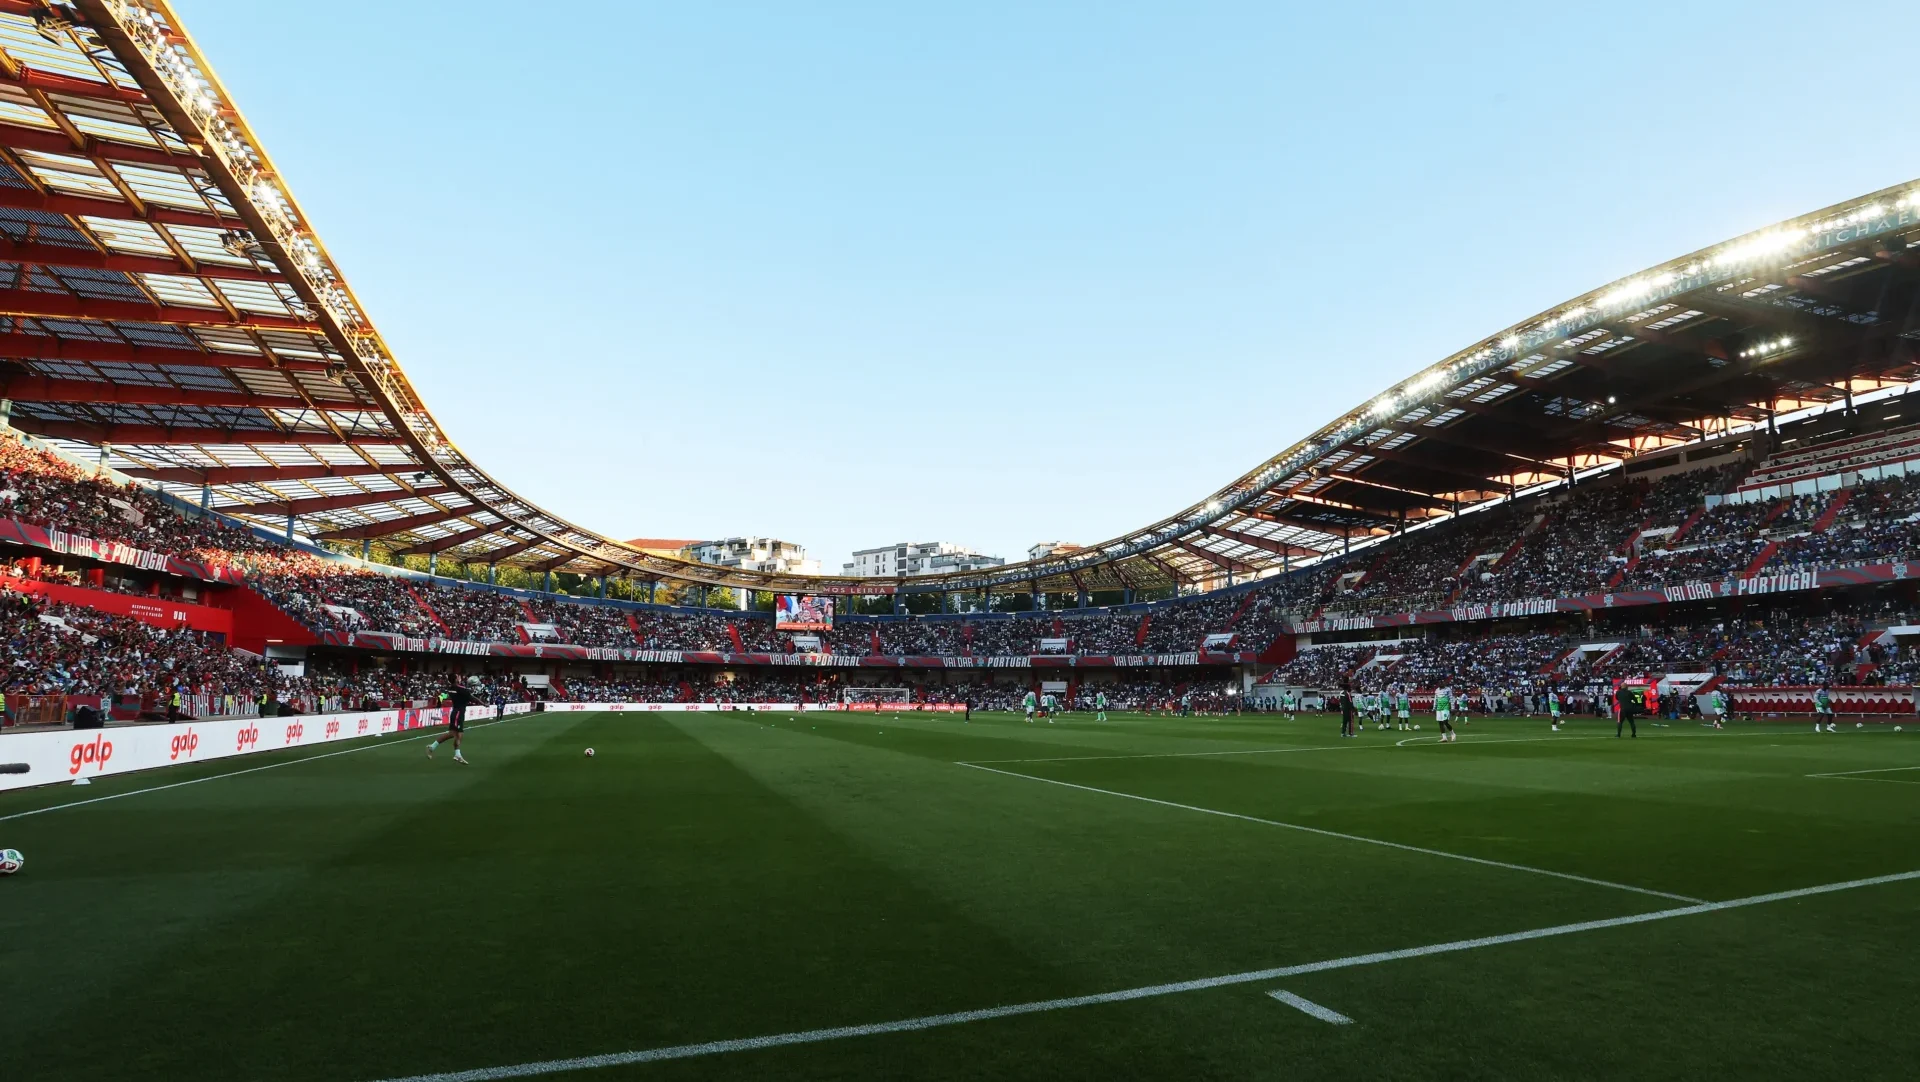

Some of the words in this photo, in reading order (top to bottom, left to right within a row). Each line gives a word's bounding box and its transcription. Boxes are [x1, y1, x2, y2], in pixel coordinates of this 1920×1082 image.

[1803, 209, 1920, 252] MICHAE
[50, 529, 68, 553] VAI
[71, 534, 93, 557] DAR
[111, 544, 169, 572] PORTUGAL
[1664, 586, 1685, 602] VAI
[1688, 583, 1713, 600] DAR
[1738, 571, 1820, 595] PORTUGAL
[1452, 608, 1467, 621] VAI
[1468, 606, 1486, 620] DAR
[1503, 599, 1558, 617] PORTUGAL
[1293, 623, 1305, 633] VAI
[1305, 621, 1320, 633] DAR
[1332, 616, 1375, 631] PORTUGAL
[392, 636, 405, 650] VAI
[407, 637, 424, 652] DAR
[438, 640, 491, 655] PORTUGAL
[585, 648, 601, 660] VAI
[603, 648, 620, 661] DAR
[635, 650, 683, 663] PORTUGAL
[769, 654, 783, 665] VAI
[785, 654, 801, 666] DAR
[815, 655, 860, 666] PORTUGAL
[943, 657, 956, 667] VAI
[958, 657, 973, 667] DAR
[987, 657, 1031, 667] PORTUGAL
[1113, 655, 1127, 666] VAI
[1128, 655, 1144, 666] DAR
[1157, 653, 1199, 666] PORTUGAL
[236, 721, 258, 751] galp
[285, 718, 303, 744] galp
[326, 717, 339, 738] galp
[69, 733, 113, 774] galp
[170, 727, 198, 760] galp
